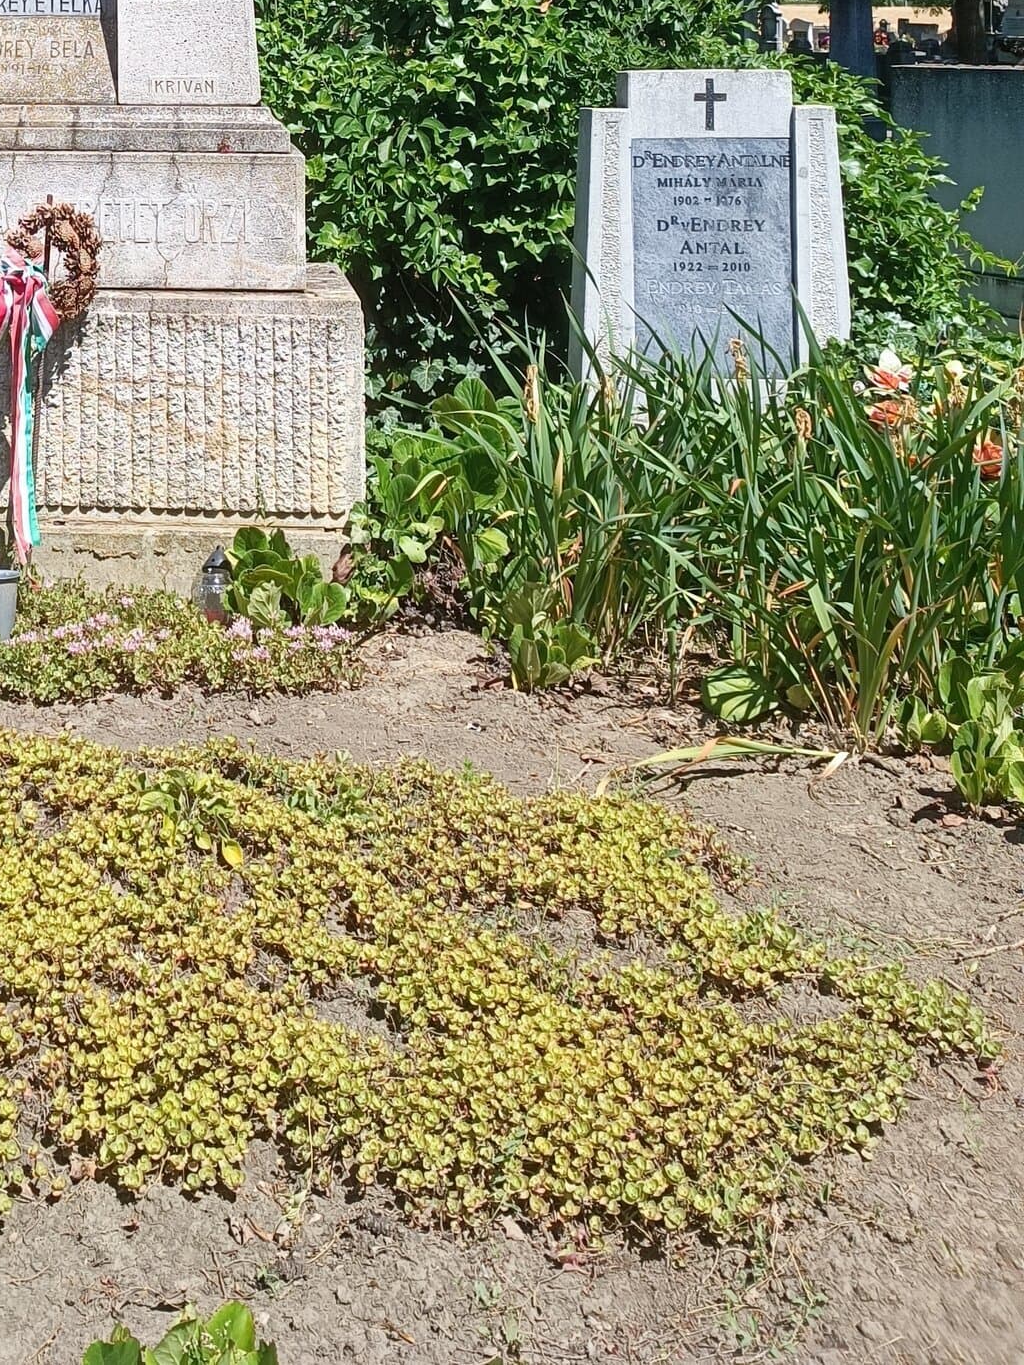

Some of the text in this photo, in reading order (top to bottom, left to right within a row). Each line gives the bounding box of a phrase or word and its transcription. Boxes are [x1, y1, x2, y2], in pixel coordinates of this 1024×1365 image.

[653, 153, 716, 169] ENDREY
[657, 174, 711, 188] MIHÁLY
[679, 240, 745, 255] ANTAL
[646, 277, 718, 295] ENDREY
